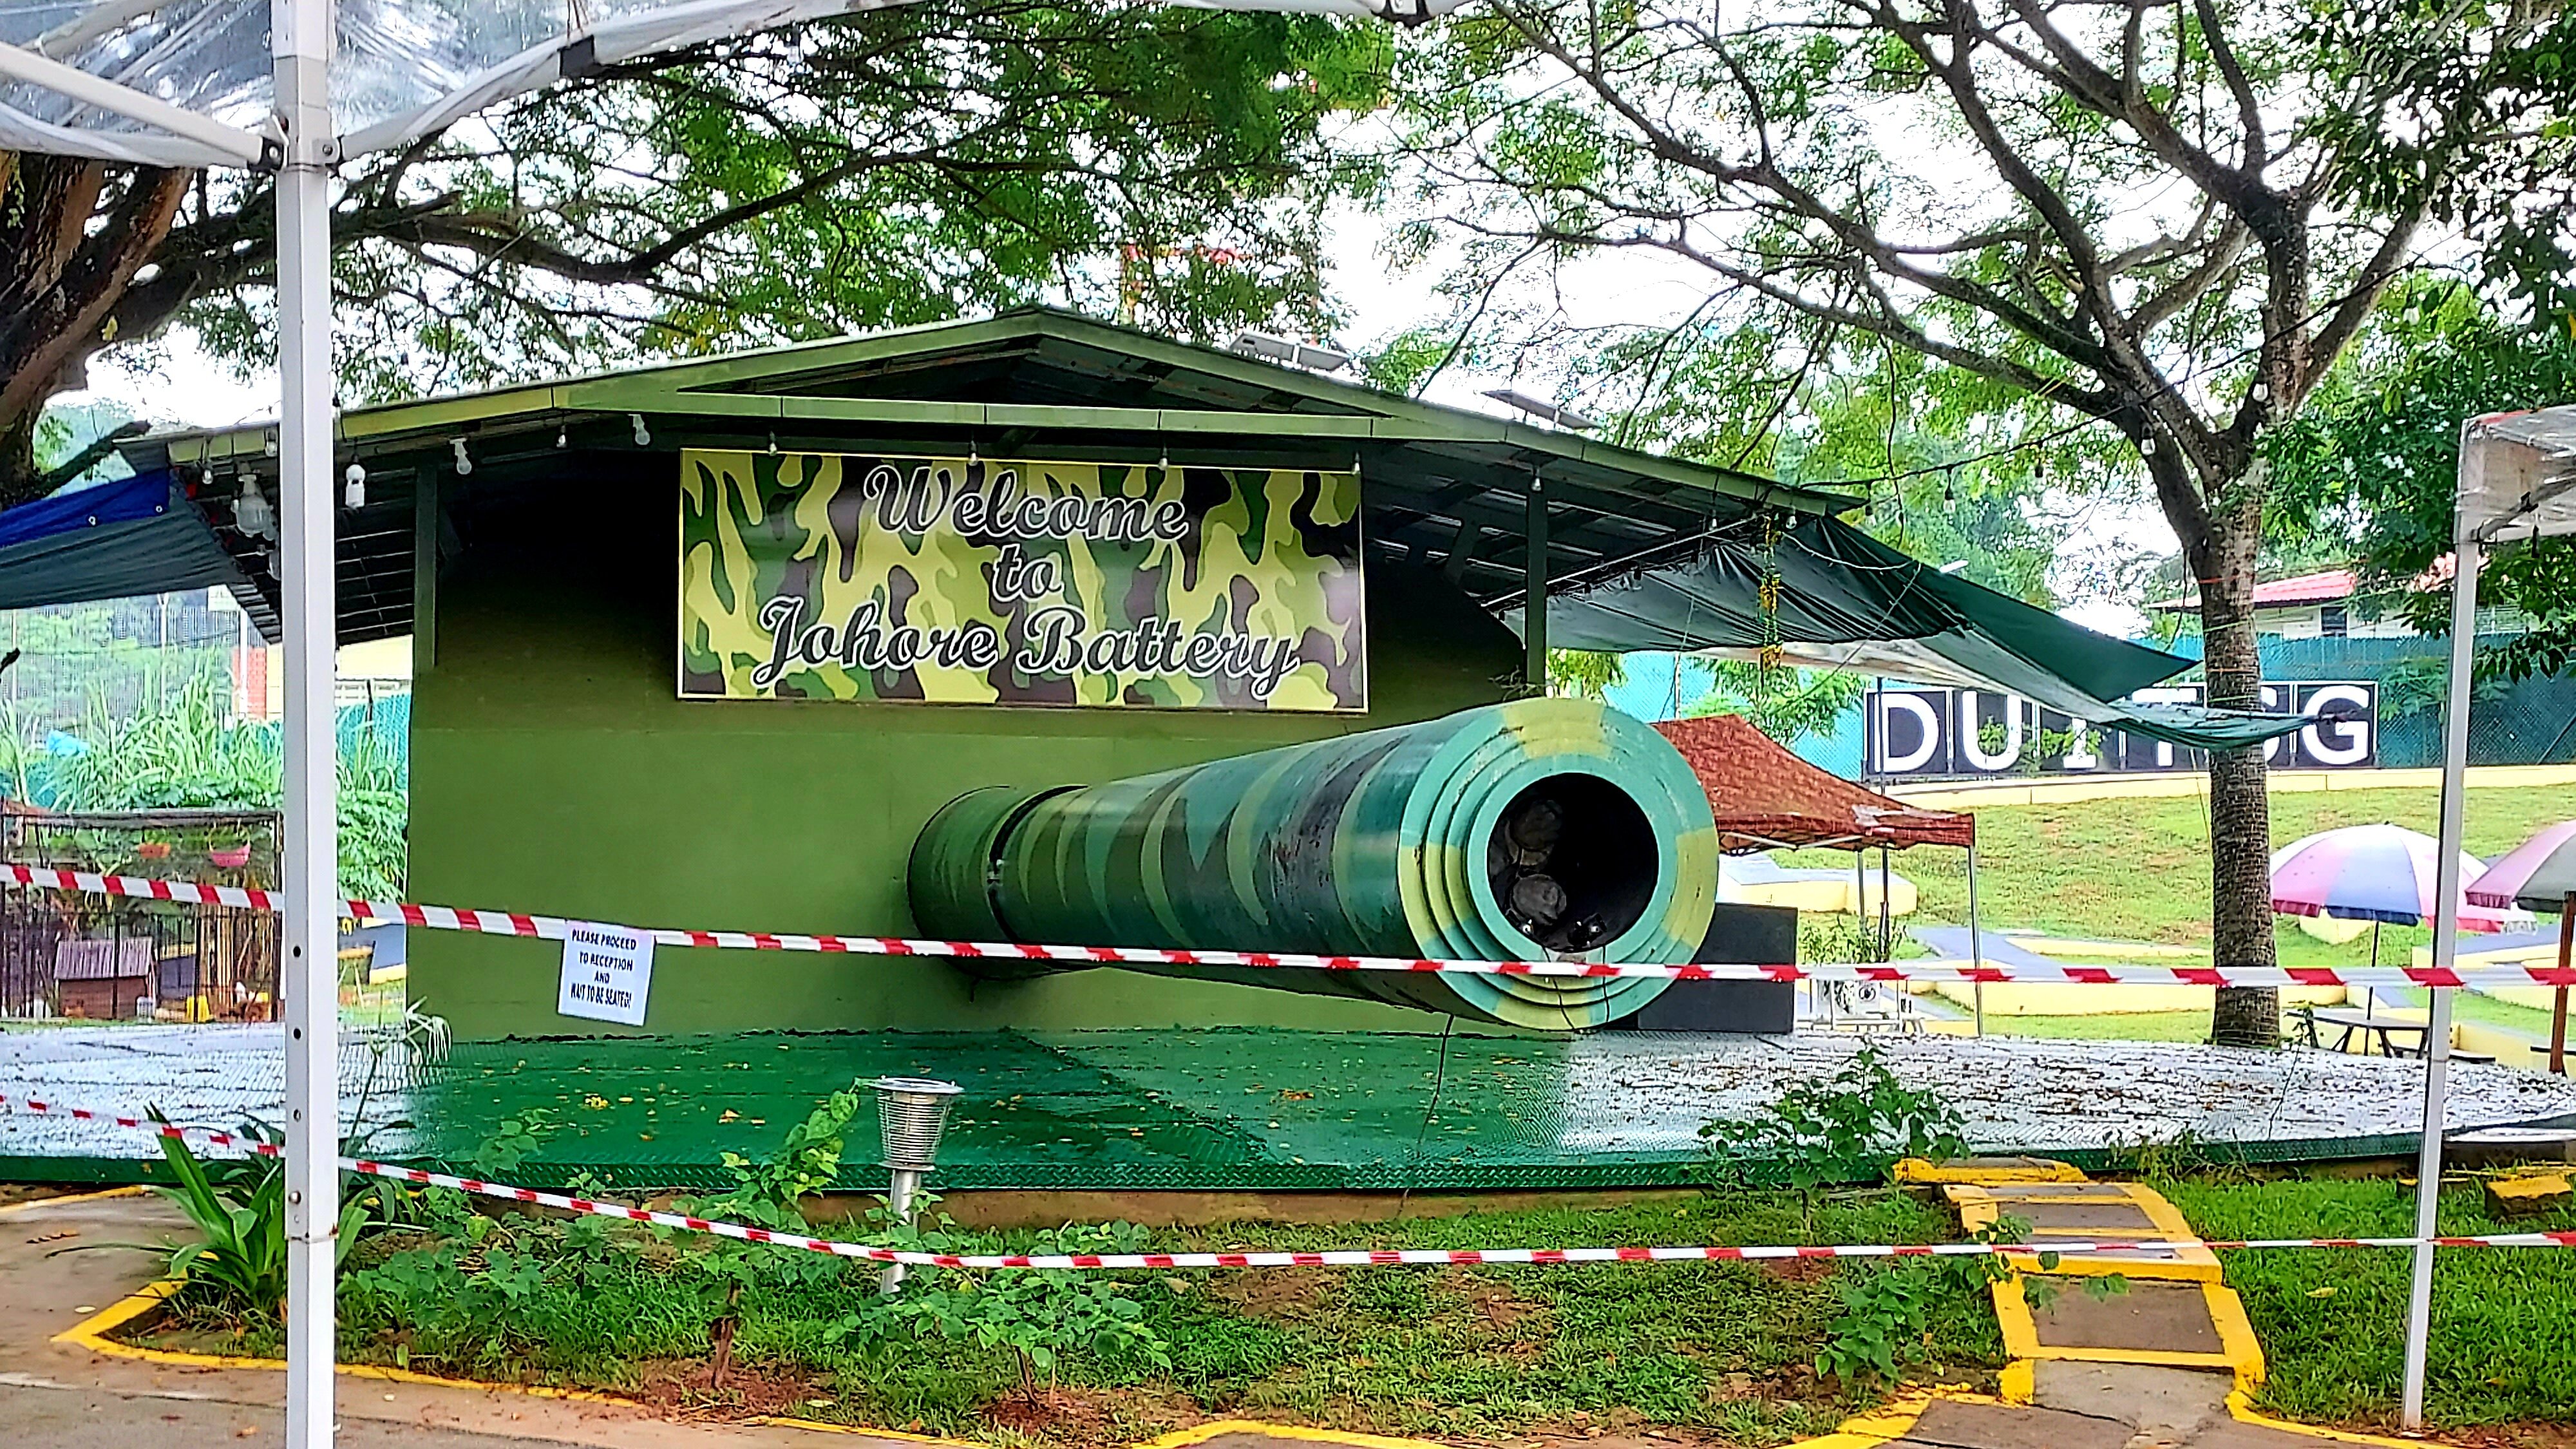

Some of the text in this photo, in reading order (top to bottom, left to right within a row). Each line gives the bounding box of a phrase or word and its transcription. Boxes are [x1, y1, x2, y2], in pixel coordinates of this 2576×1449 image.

[863, 464, 1190, 542] Welcome
[992, 544, 1065, 602] to
[750, 594, 1300, 700] Johore Battery
[572, 929, 636, 950] PLEASE PROCEED
[580, 951, 632, 971] TO RECEPTION
[594, 971, 610, 983] AND
[587, 985, 594, 1002] TO
[596, 987, 604, 1004] BE
